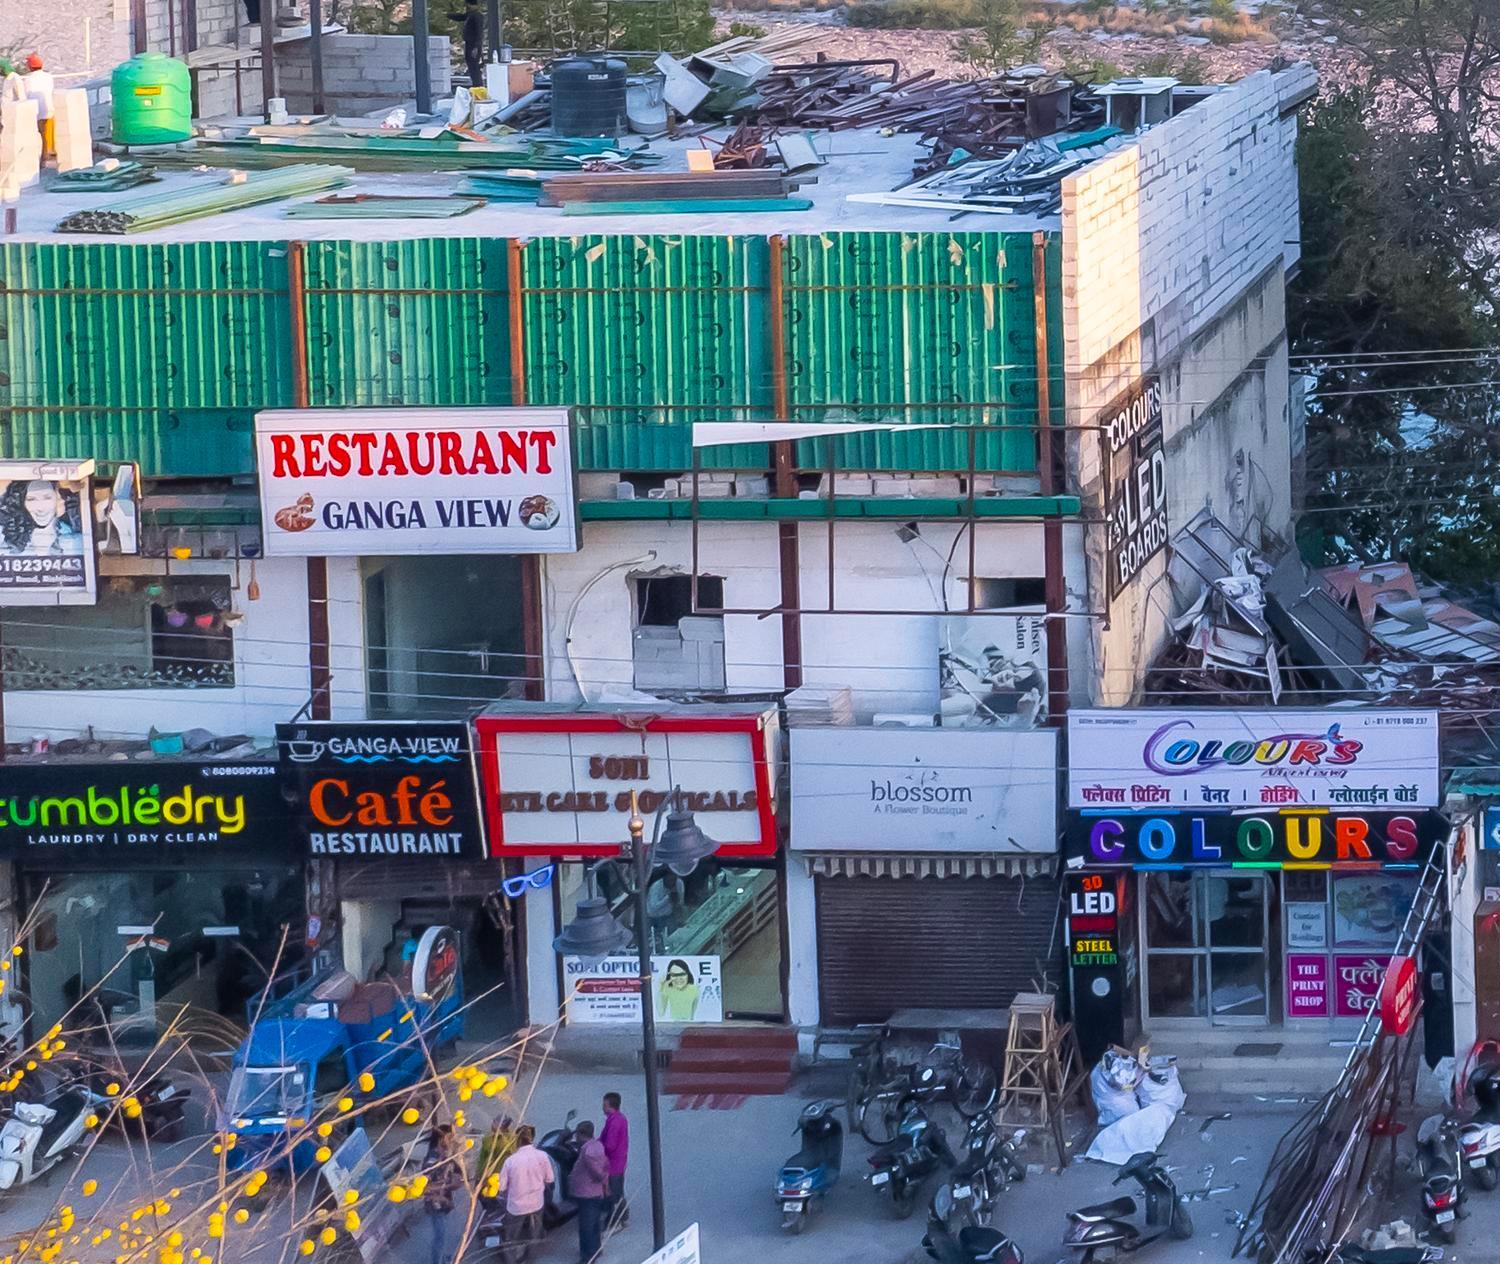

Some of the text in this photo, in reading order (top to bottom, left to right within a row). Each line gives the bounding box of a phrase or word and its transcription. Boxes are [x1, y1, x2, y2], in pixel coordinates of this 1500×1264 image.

[1110, 382, 1161, 452] COLOURS
[271, 431, 556, 477] RESTAURANT
[1125, 449, 1166, 536] LED
[322, 499, 512, 530] GANGA VIEW
[1119, 510, 1167, 585] BOARDS
[328, 738, 459, 753] GANGA VIEW
[309, 775, 454, 825] Café
[870, 780, 972, 802] blossom
[874, 804, 968, 816] A Flower Boutique
[28, 832, 218, 845] LAUNDRY DRY CLEAN
[310, 832, 462, 853] RESTAURANT
[1090, 817, 1419, 861] COLOURS
[1082, 875, 1103, 891] 3D
[1071, 892, 1115, 914] LED
[1076, 940, 1113, 952] STEEL
[1073, 953, 1117, 965] LETTER
[1297, 965, 1319, 975] THE
[1292, 981, 1325, 991] PRINT
[1295, 996, 1323, 1007] SHOP
